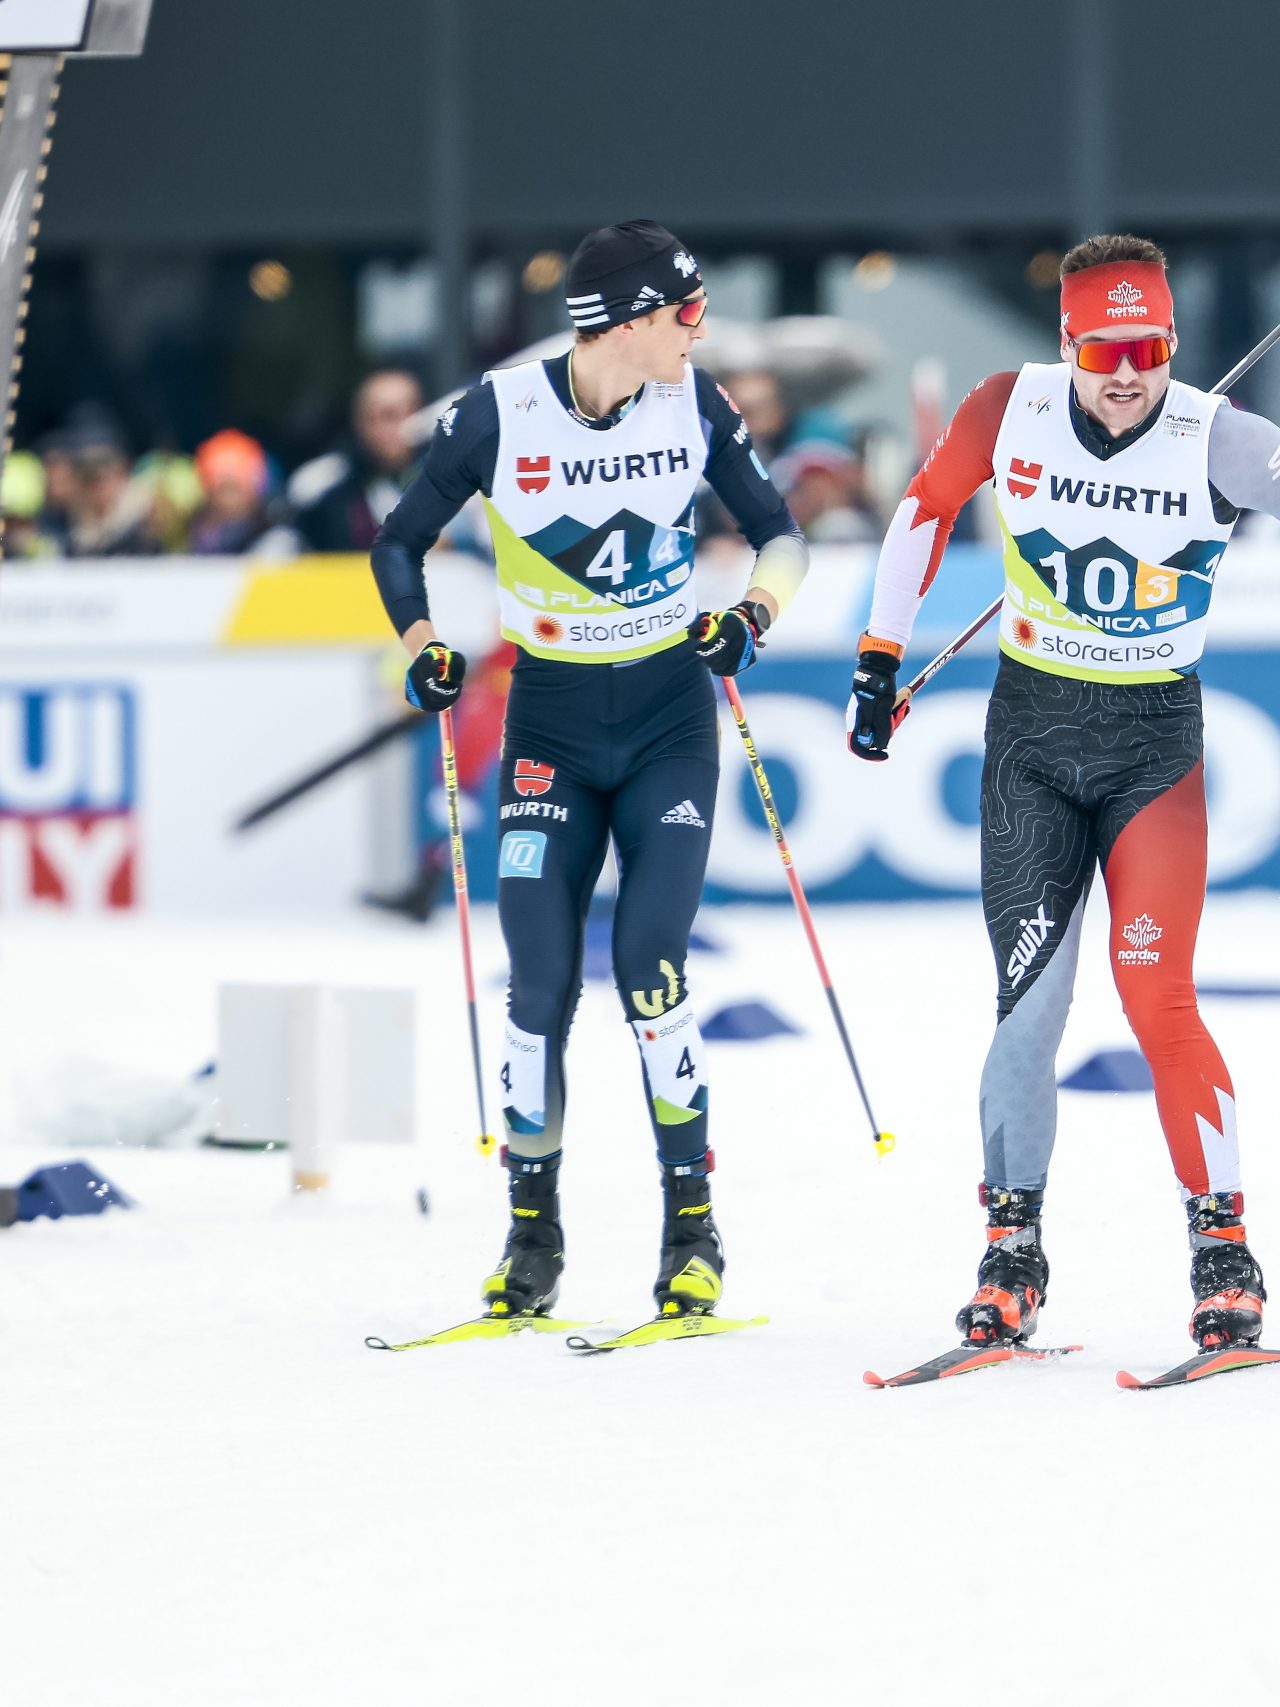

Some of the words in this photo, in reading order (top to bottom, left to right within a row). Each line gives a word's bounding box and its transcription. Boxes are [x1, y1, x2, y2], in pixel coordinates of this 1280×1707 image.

[1107, 304, 1147, 315] nordiq
[1166, 414, 1200, 425] PLANICA
[561, 447, 690, 486] WÜRTH
[1050, 475, 1187, 516] WÜRTH
[586, 530, 633, 585] 4
[655, 531, 675, 562] 4
[551, 579, 667, 608] PLANICA
[1039, 551, 1129, 612] 10
[1145, 575, 1171, 603] 3
[570, 603, 686, 642] storaenso
[1028, 597, 1151, 632] PLANICA
[1042, 635, 1174, 662] storaenso
[500, 801, 568, 822] WÜRTH
[661, 814, 706, 828] adidas
[1118, 949, 1160, 964] nordiq
[500, 1061, 512, 1093] 4
[675, 1046, 696, 1079] 4
